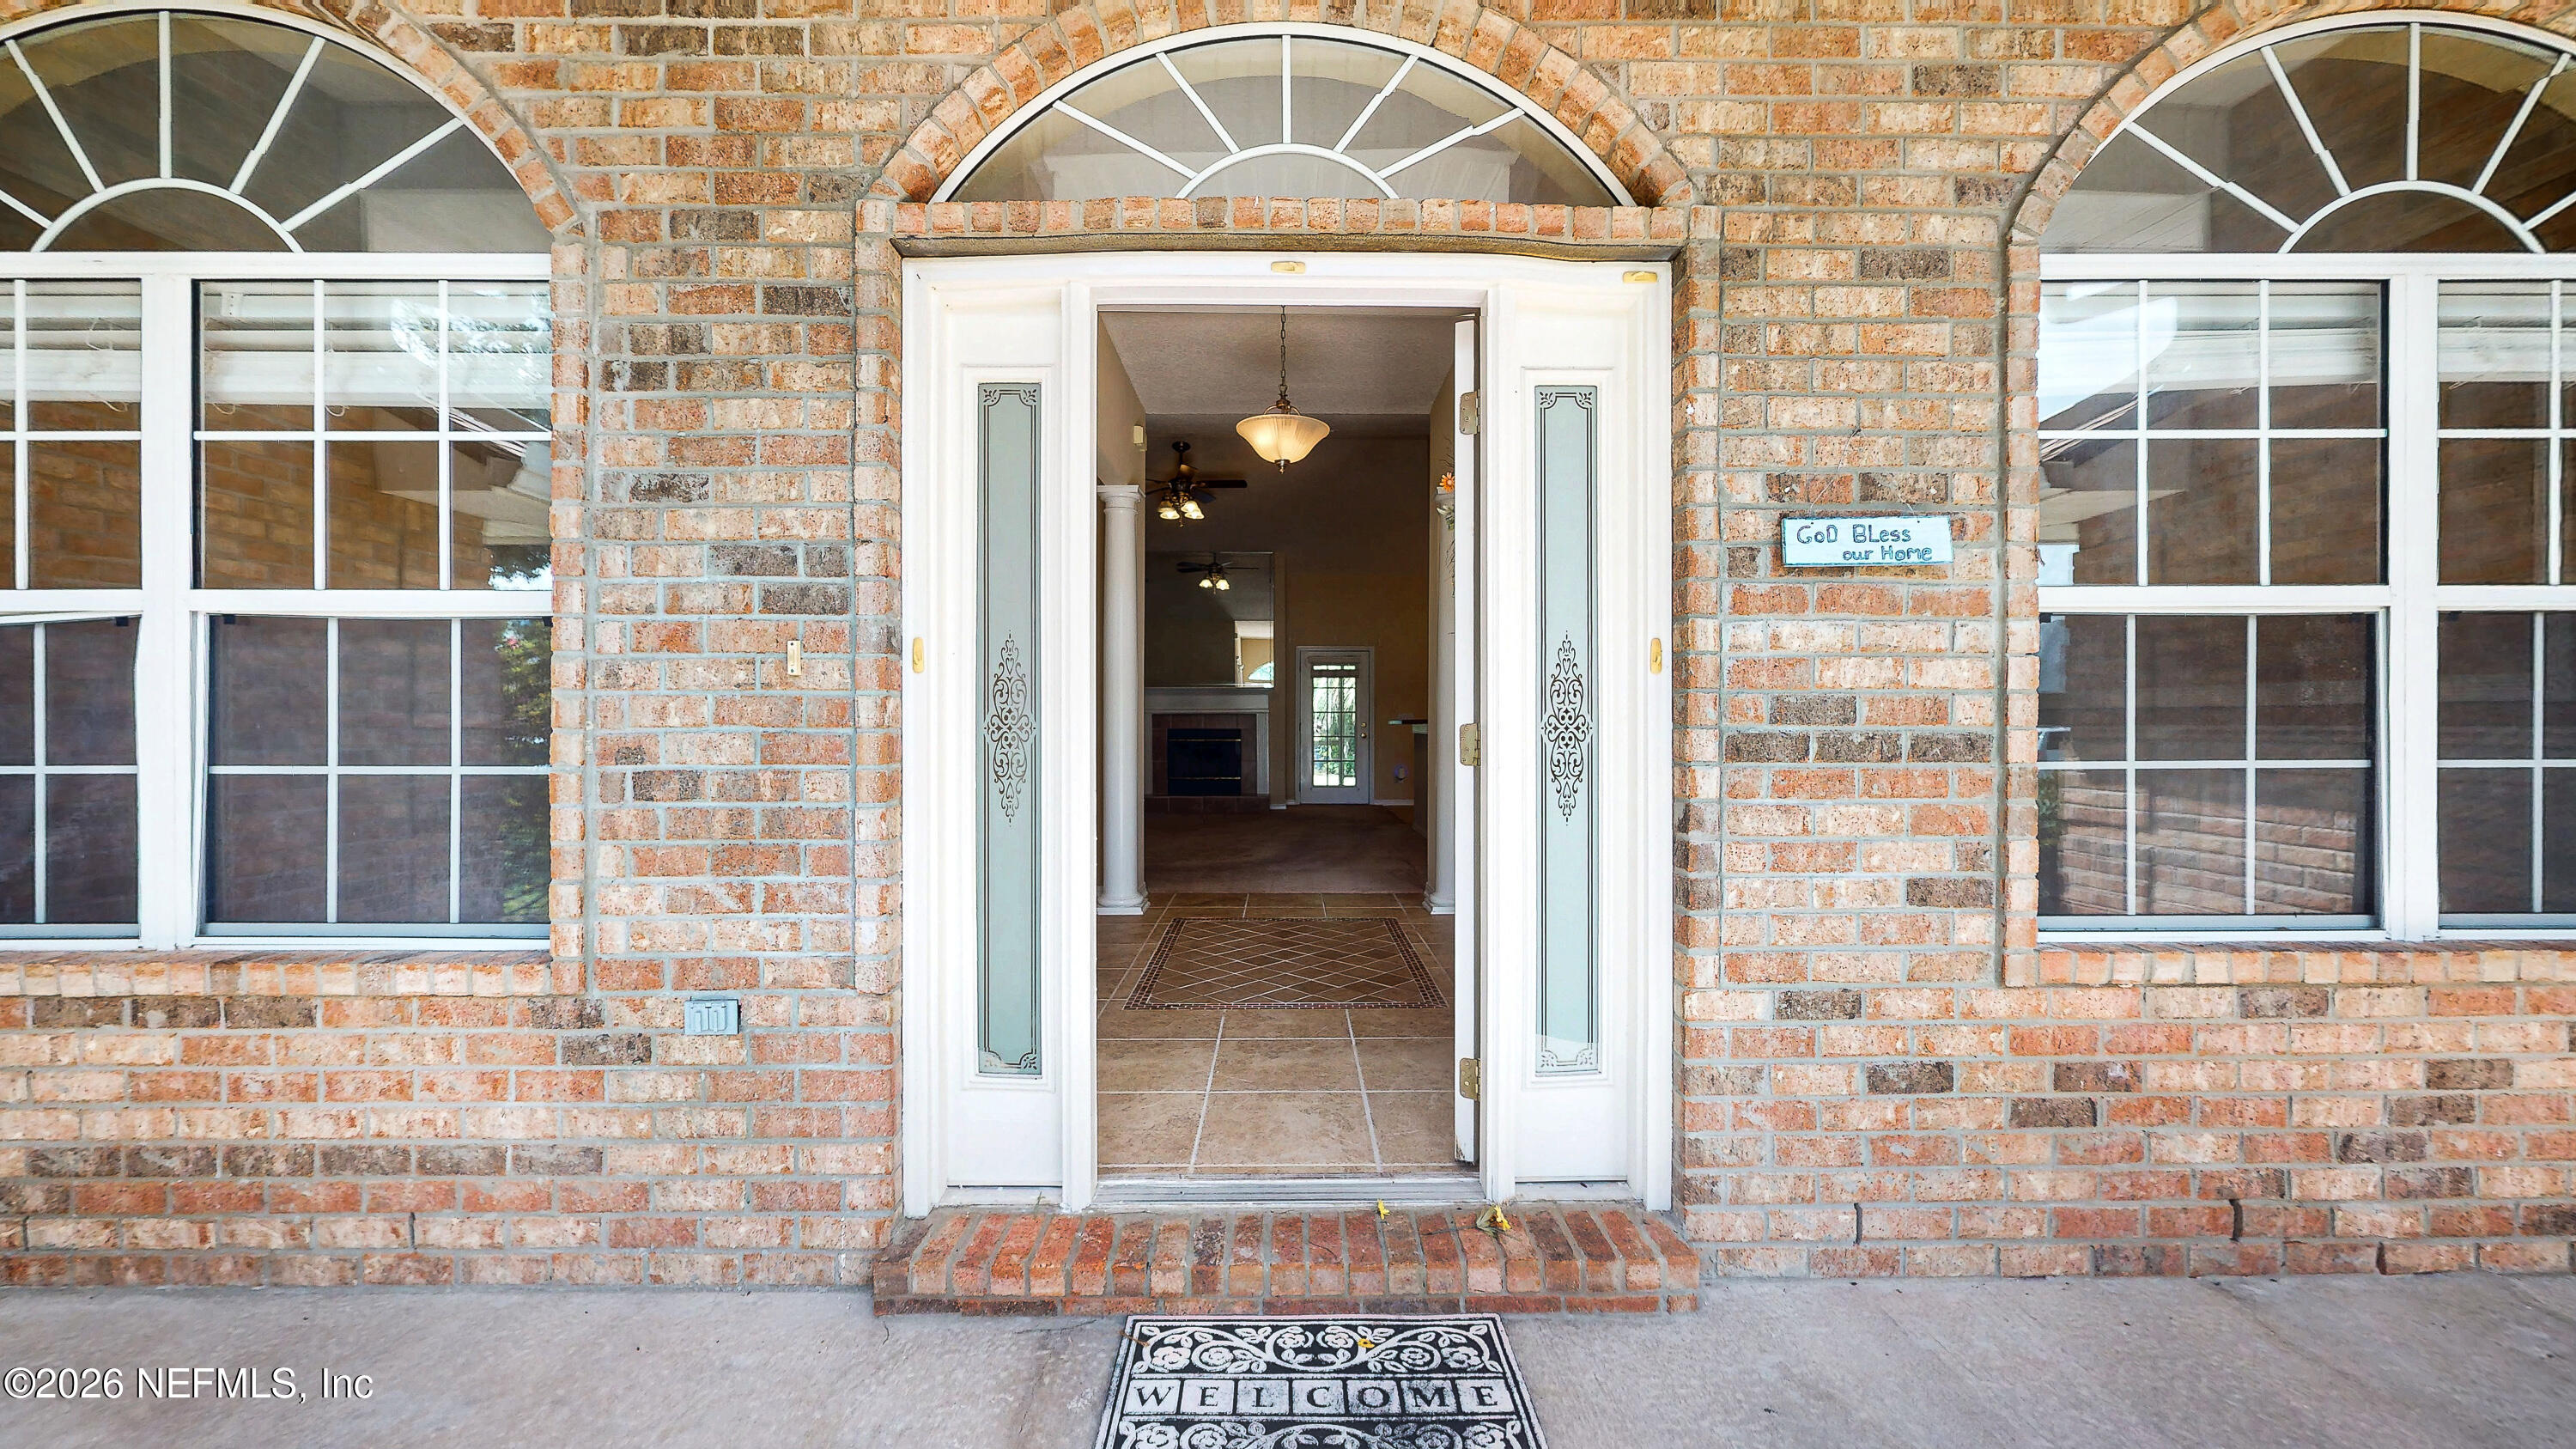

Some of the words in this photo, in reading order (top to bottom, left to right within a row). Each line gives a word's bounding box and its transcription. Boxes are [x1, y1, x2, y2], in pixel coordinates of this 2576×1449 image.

[1843, 548, 1874, 561] our
[1880, 545, 1933, 561] Home
[1135, 1385, 1506, 1409] WELCOME
